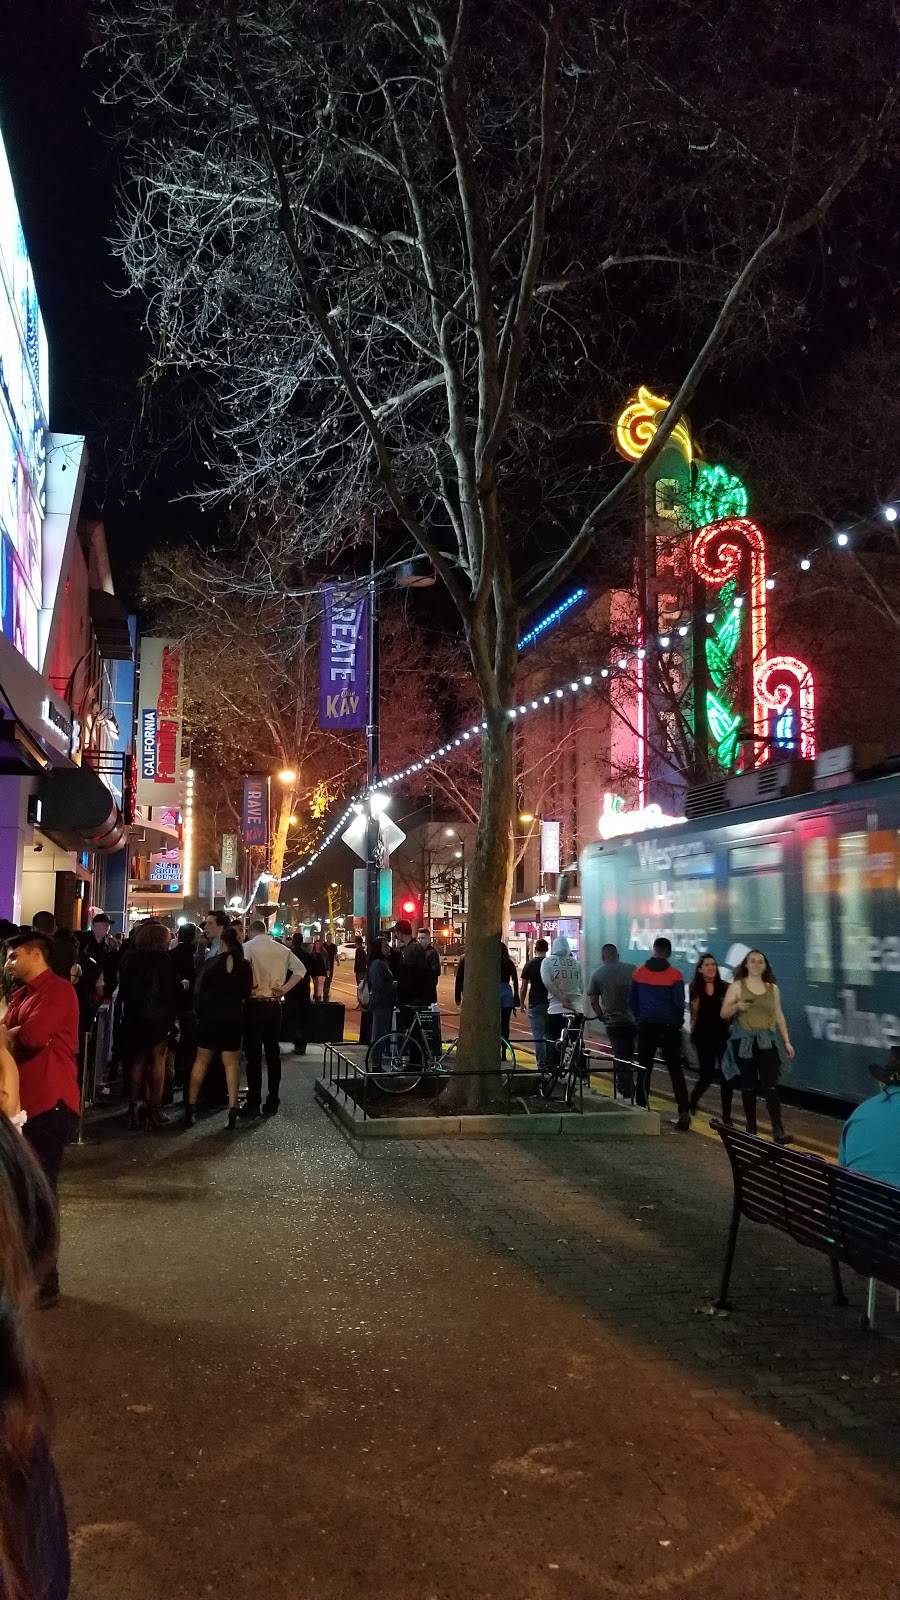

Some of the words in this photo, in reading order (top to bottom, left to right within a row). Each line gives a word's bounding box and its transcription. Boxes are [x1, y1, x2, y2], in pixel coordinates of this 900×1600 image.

[326, 694, 360, 719] KAY
[143, 711, 155, 777] CALIFORNIA
[153, 719, 179, 784] Family
[248, 782, 262, 825] KRAVE
